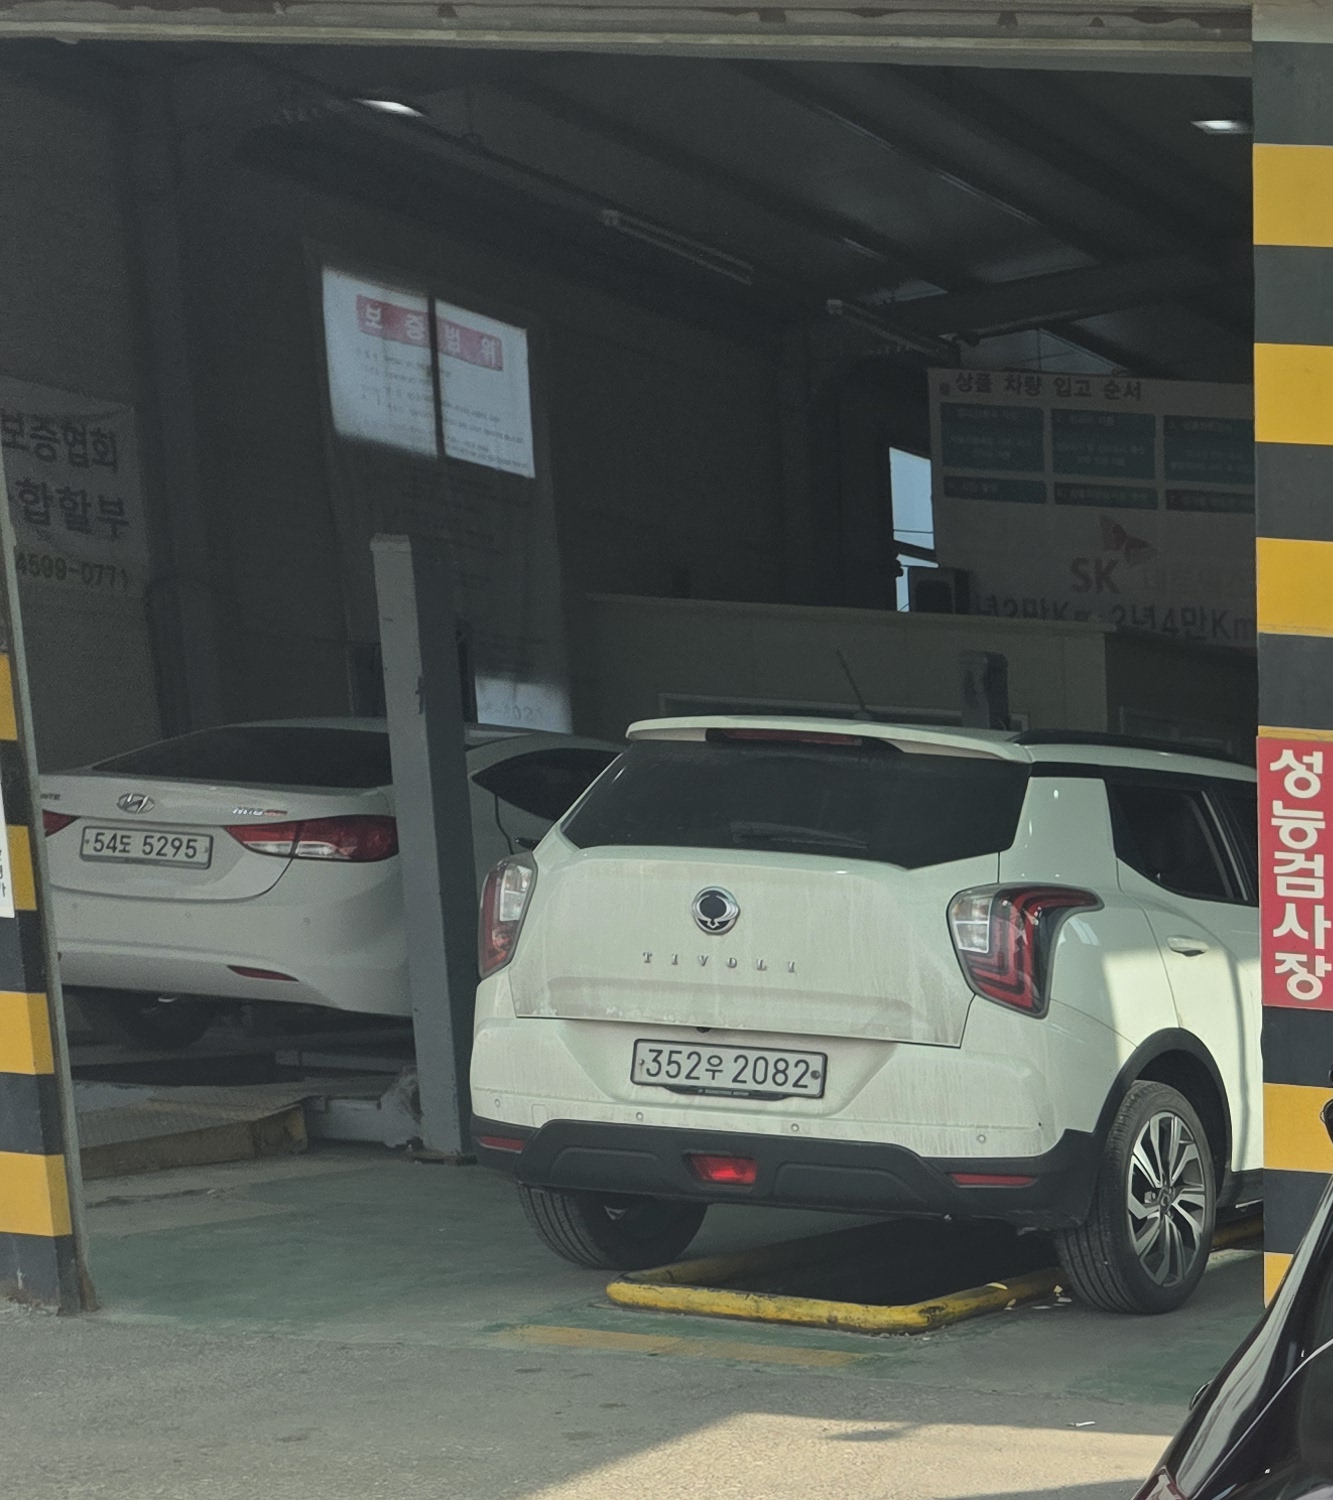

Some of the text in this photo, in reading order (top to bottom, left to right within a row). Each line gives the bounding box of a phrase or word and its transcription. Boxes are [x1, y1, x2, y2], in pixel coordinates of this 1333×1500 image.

[955, 372, 1142, 400] 상품 차량 입고 순서
[14, 478, 129, 541] 합할부
[1071, 557, 1120, 594] SK
[93, 832, 198, 859] 54도 5295
[1270, 749, 1333, 1000] 성능검사장
[643, 952, 796, 973] TIVOLI
[646, 1048, 810, 1089] 352우 2082
